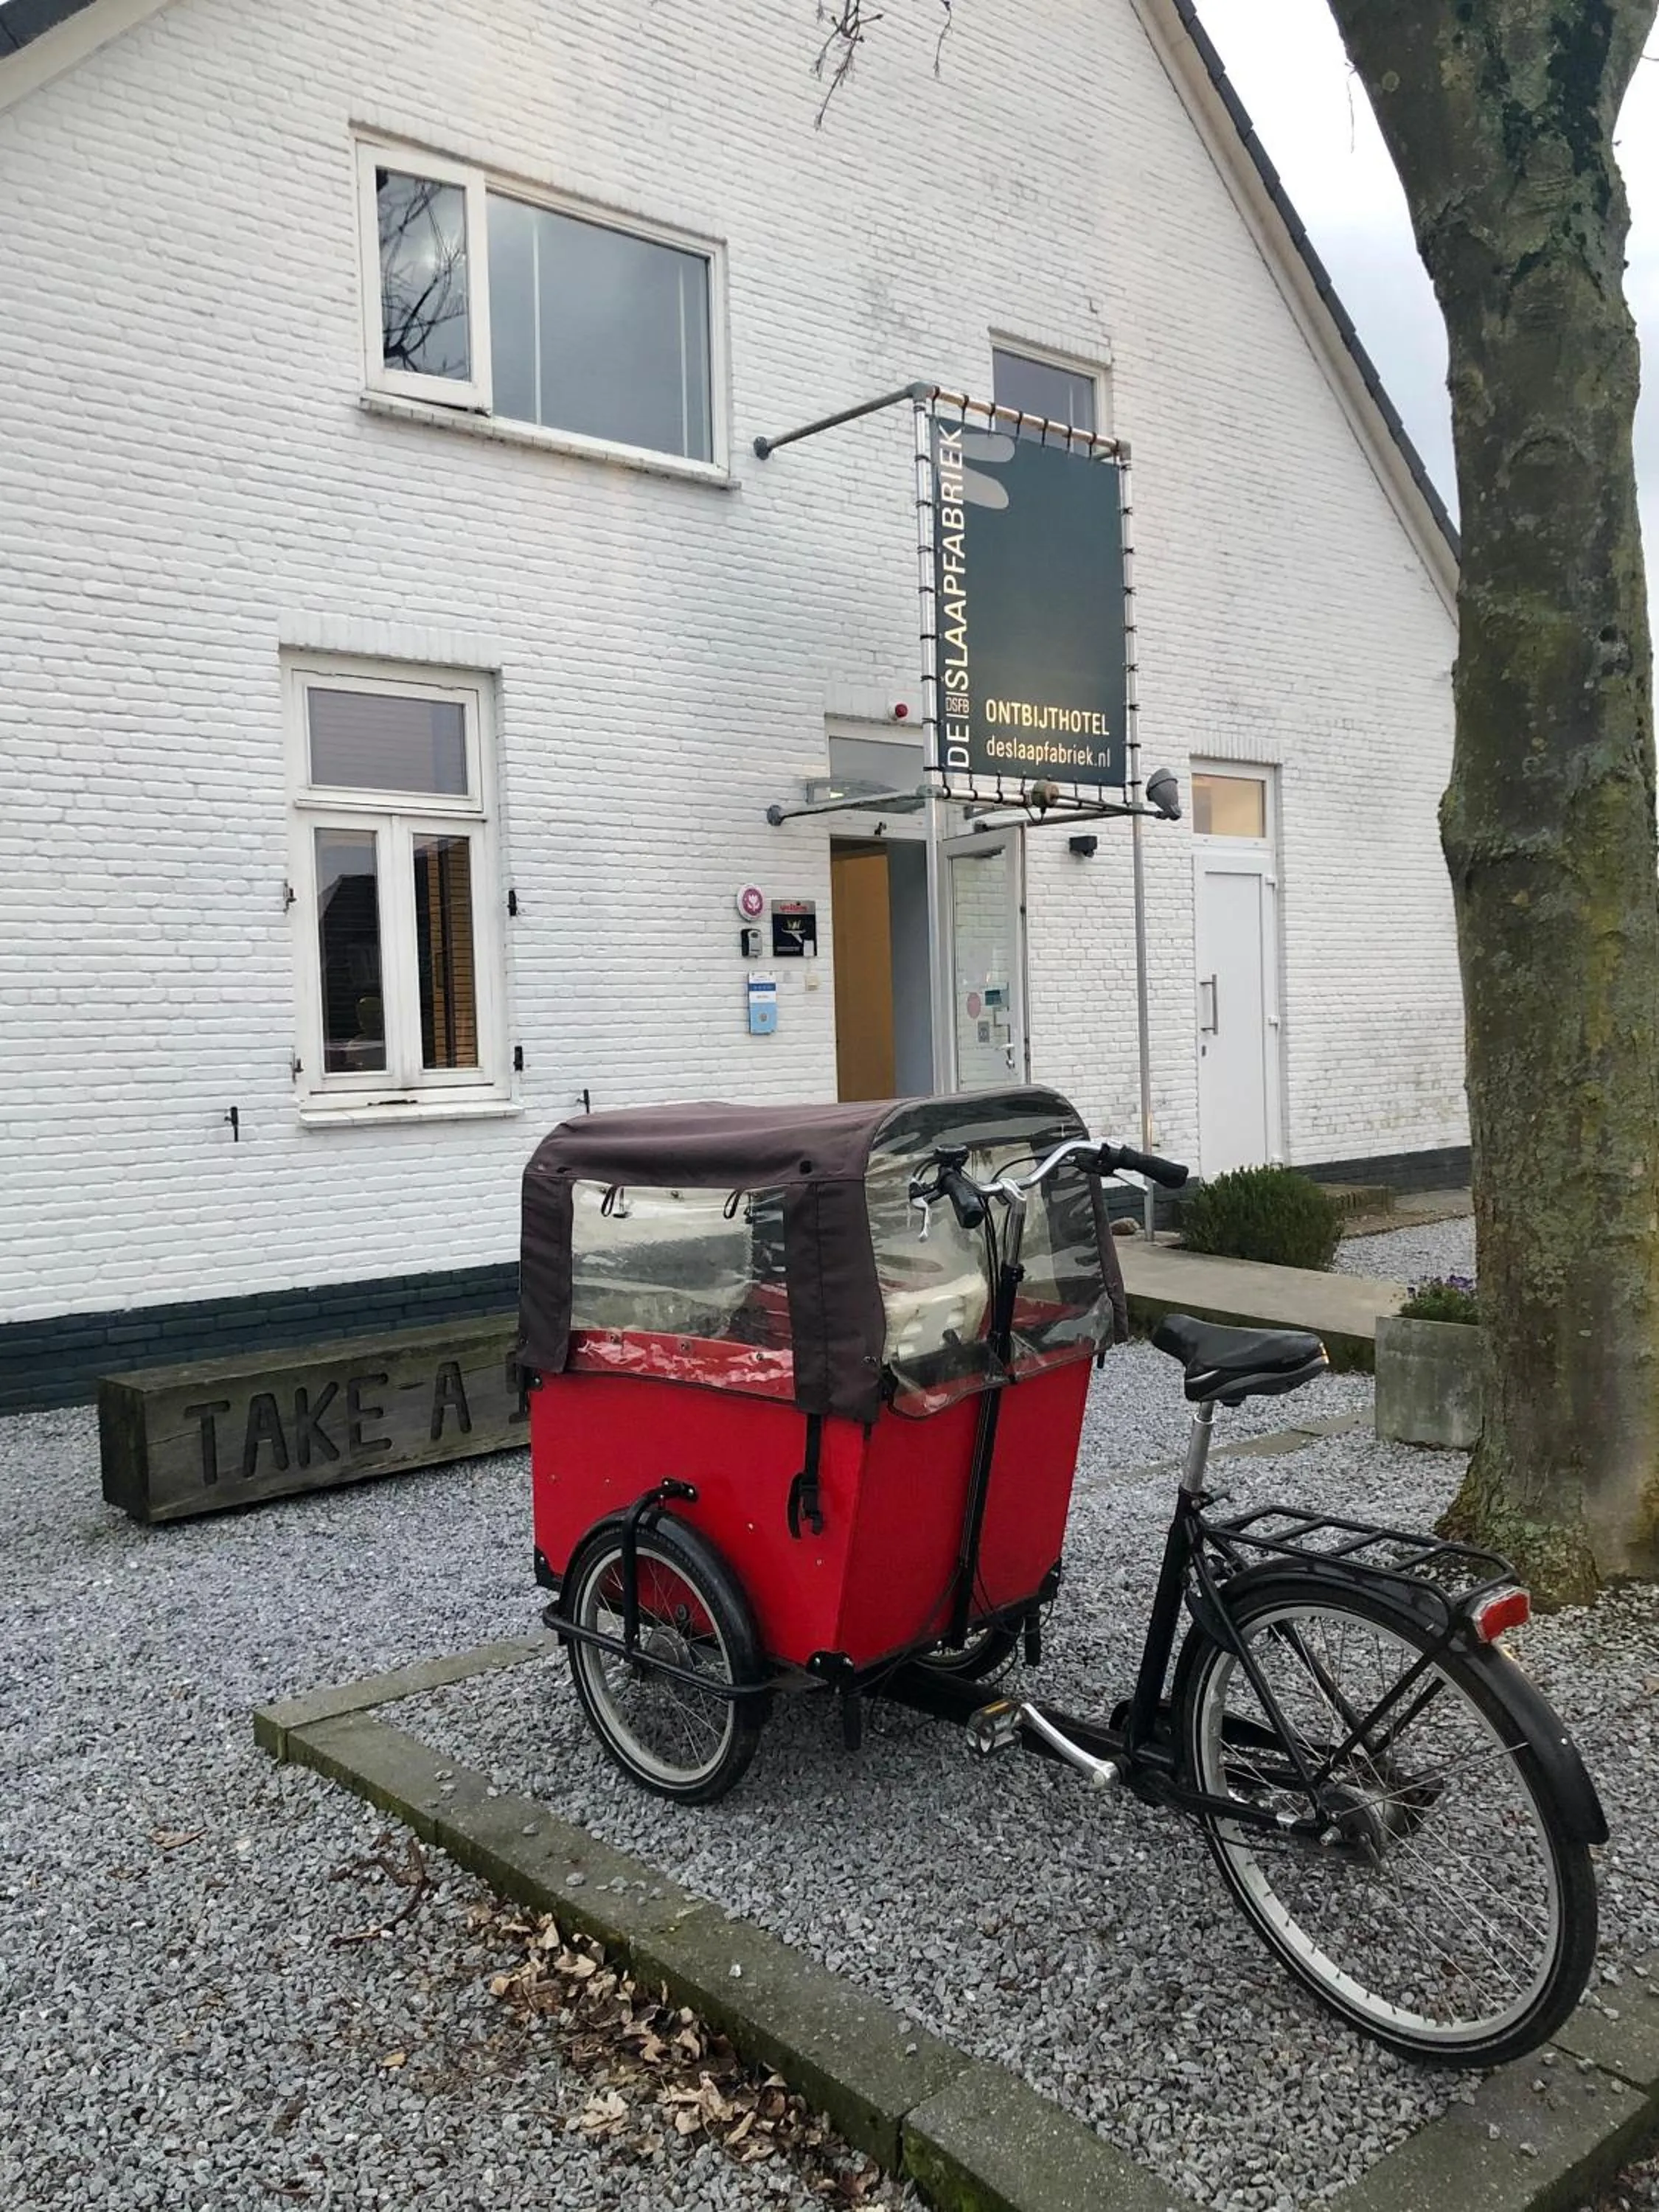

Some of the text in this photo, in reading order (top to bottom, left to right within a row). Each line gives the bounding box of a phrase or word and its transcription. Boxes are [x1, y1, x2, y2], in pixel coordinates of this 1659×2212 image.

[939, 425, 970, 768] DE SLAAPFABRIEK
[945, 697, 970, 713] DSFB
[986, 699, 1110, 735] ONTBIJTHOTEL
[986, 734, 1110, 768] deslaapfabriek.nl
[184, 1371, 393, 1486] TAKE
[430, 1361, 473, 1441] A
